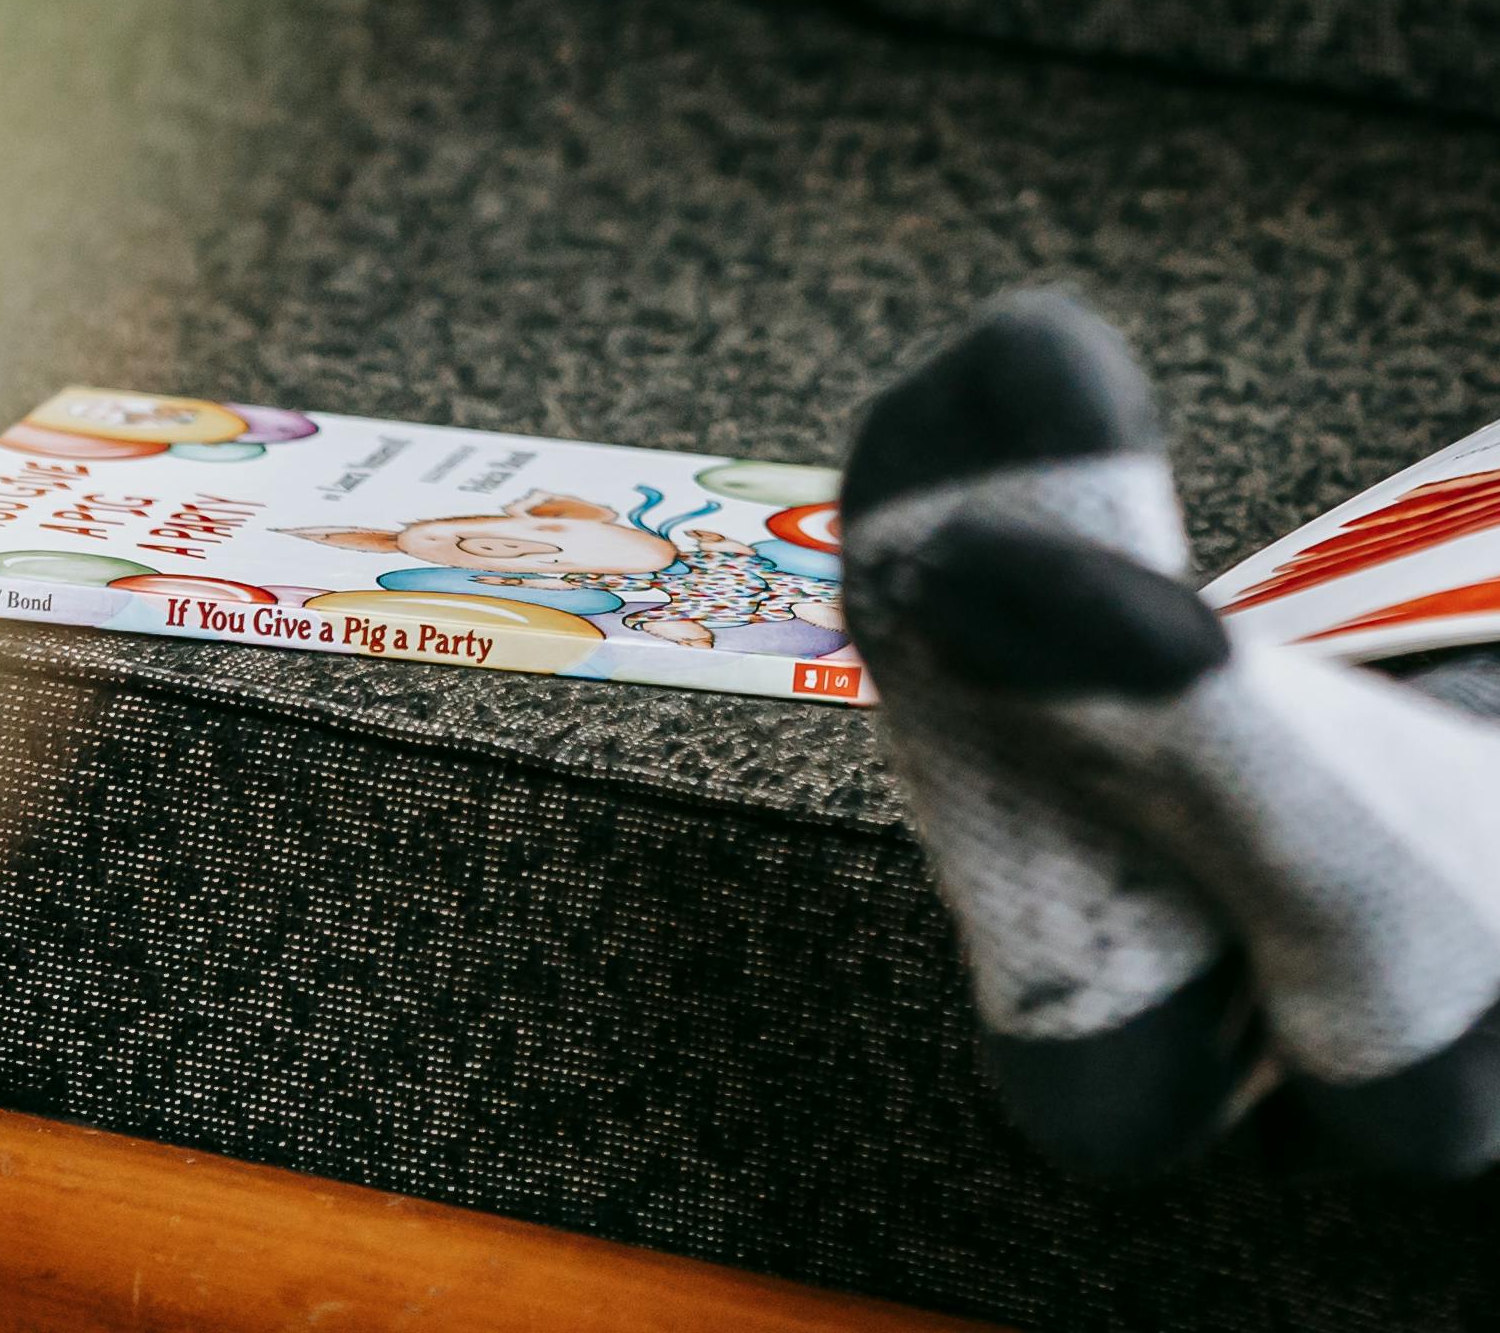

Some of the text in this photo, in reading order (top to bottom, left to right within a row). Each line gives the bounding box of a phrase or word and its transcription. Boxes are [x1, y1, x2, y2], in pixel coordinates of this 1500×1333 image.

[39, 493, 160, 540] A PIG
[136, 492, 268, 560] A PARTY
[7, 590, 53, 613] Bond
[165, 598, 493, 664] If You Give a Pig a Party
